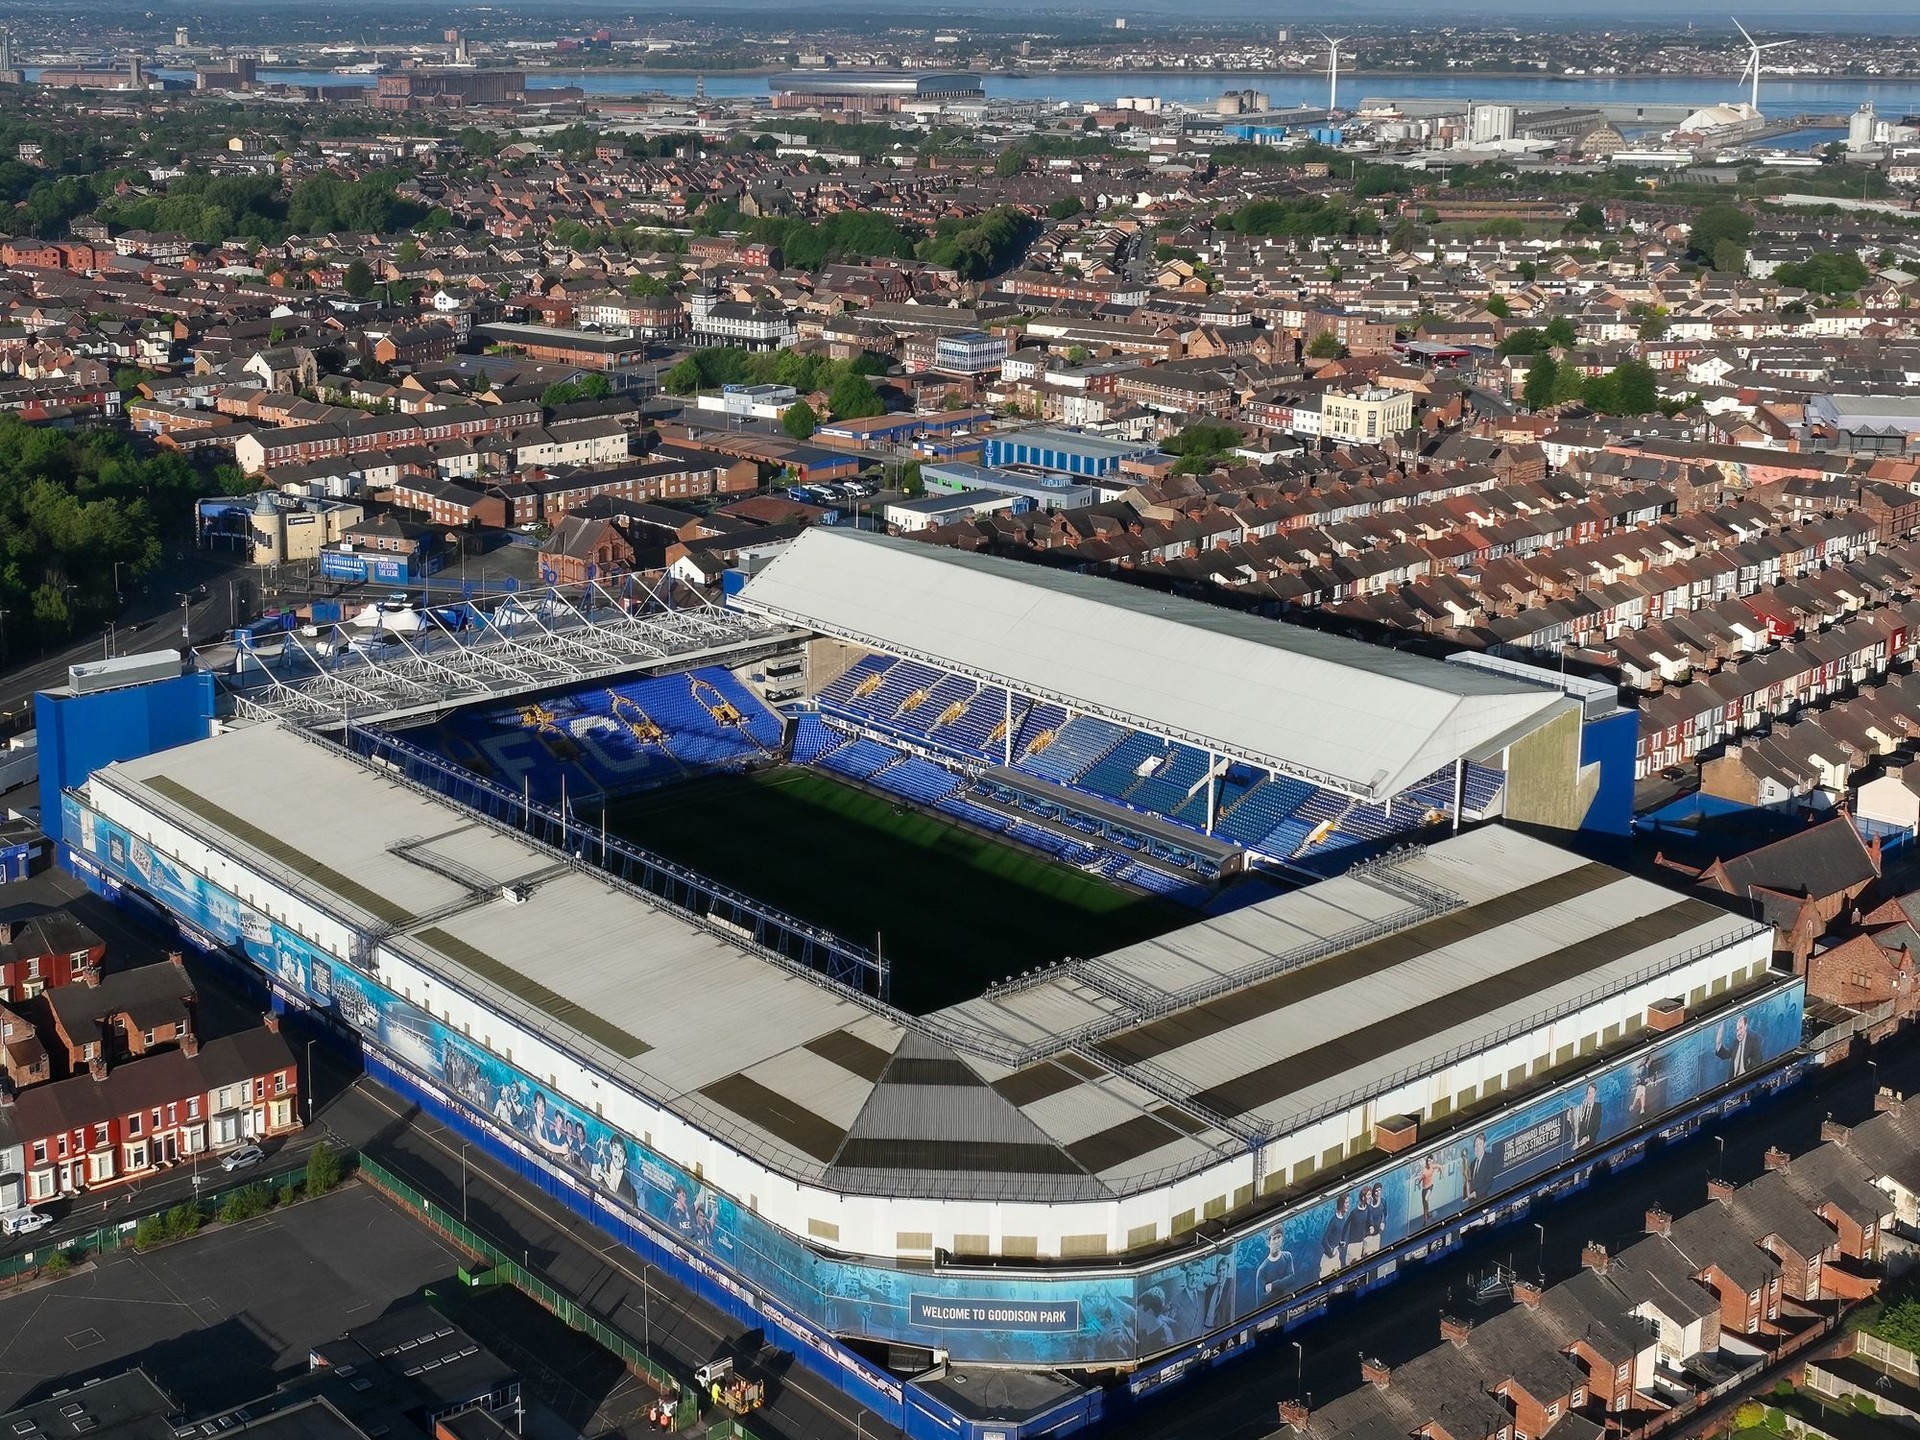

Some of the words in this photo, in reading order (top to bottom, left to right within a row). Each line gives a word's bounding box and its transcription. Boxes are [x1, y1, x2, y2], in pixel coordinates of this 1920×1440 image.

[522, 682, 545, 692] PHILIP
[547, 677, 572, 687] CARTER
[575, 672, 592, 681] PARK
[595, 668, 617, 677] STAND
[1504, 1138, 1515, 1152] THE
[1529, 1132, 1549, 1151] STREET
[1549, 1127, 1560, 1141] END
[922, 1305, 970, 1320] WELCOME
[972, 1308, 985, 1321] TO
[988, 1310, 1037, 1323] GOODISON
[1040, 1311, 1066, 1323] PARK
